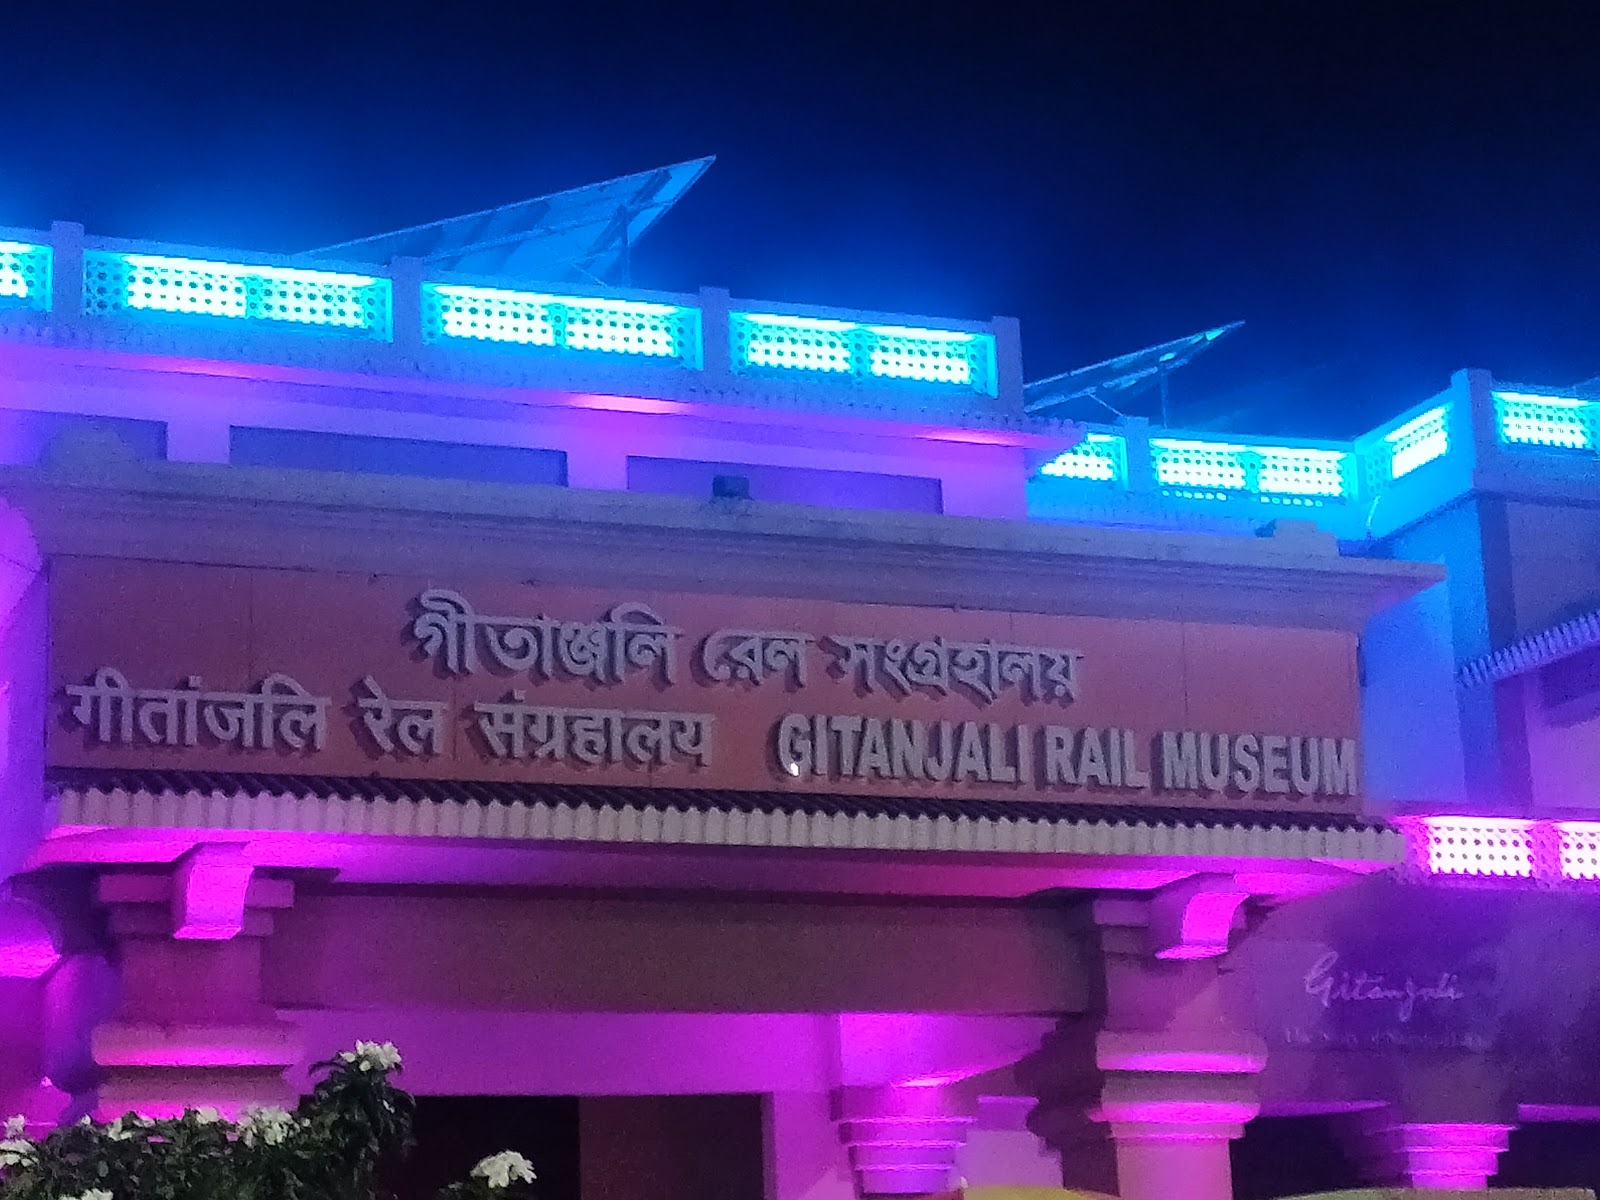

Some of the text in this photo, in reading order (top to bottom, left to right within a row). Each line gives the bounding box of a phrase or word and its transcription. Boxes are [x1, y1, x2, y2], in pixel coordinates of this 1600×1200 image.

[414, 588, 1085, 704] গীতাঞ্জলি রেল সংগ্রহালয়
[65, 669, 715, 766] गीतांजलि रेल संग्रहालय
[778, 714, 1356, 797] GITANJALI RAIL MUSEUM
